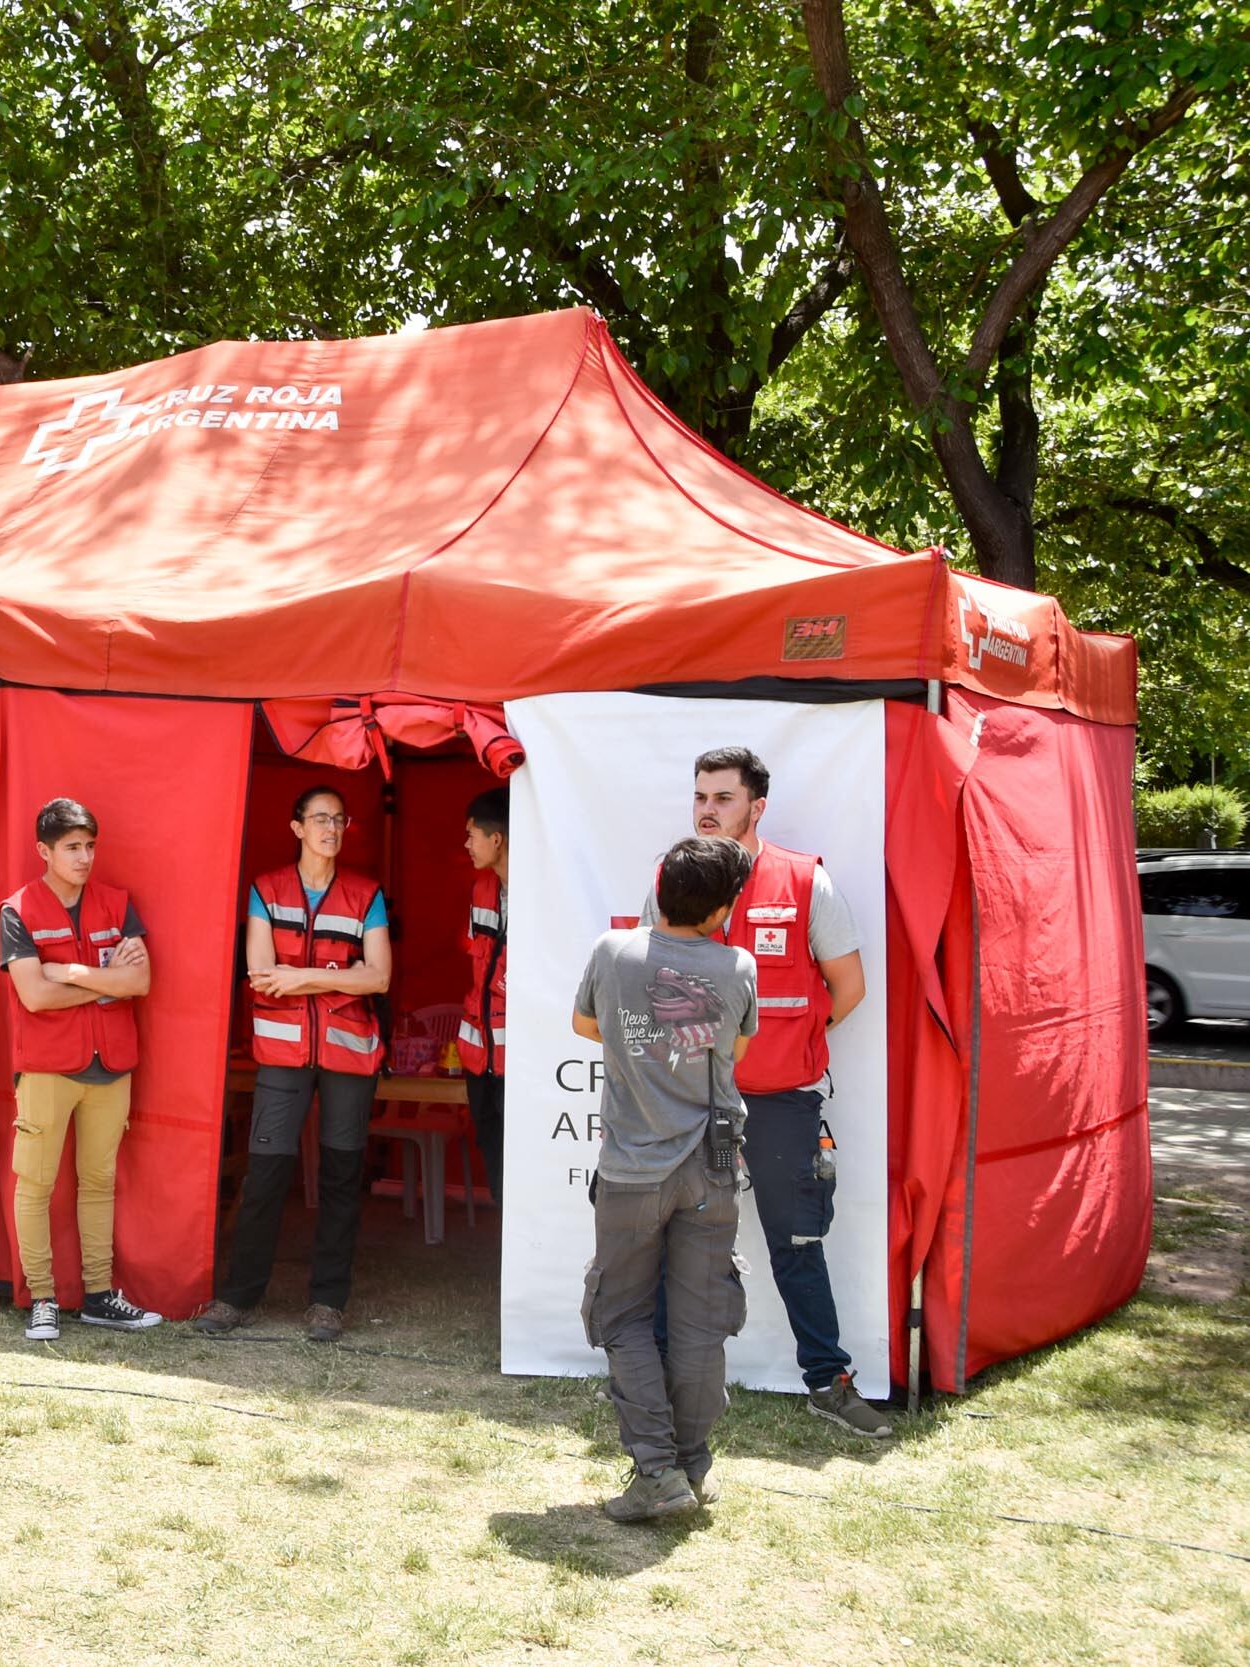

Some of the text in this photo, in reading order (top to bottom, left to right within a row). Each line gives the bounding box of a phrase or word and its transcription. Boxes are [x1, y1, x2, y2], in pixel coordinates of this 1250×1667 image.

[141, 383, 343, 415] CRUZ ROJA
[125, 407, 340, 439] ARGENTINA
[988, 635, 1028, 668] ARGENTINA
[623, 1025, 666, 1044] give up
